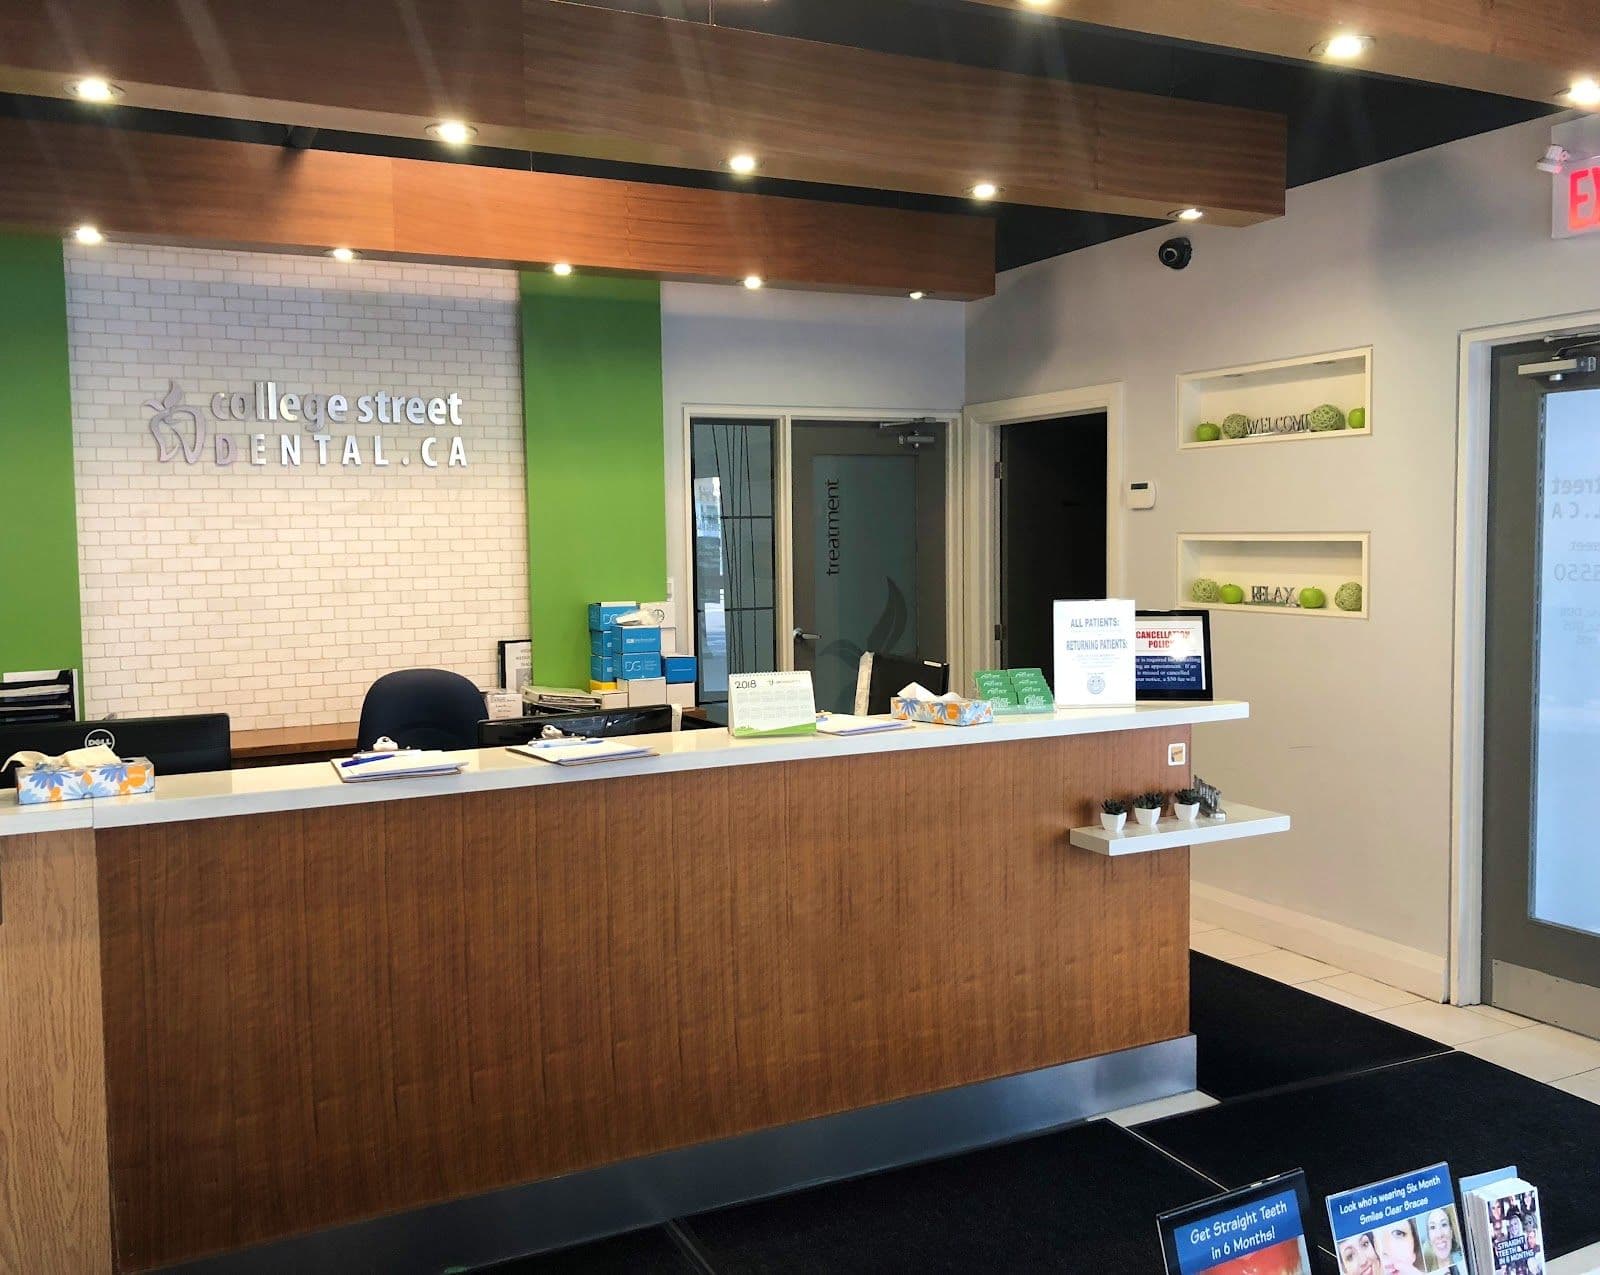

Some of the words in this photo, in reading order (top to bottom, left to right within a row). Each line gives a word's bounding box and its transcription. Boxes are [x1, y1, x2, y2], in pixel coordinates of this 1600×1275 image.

[211, 381, 348, 433] college
[357, 390, 463, 426] street
[826, 479, 840, 576] treatment
[1070, 618, 1083, 628] ALL
[1085, 617, 1120, 628] PATIENTS:
[1066, 640, 1098, 651] RETURNING
[1100, 638, 1128, 650] PATIENTS:
[734, 680, 757, 689] 2018
[1339, 1202, 1358, 1215] Look
[1358, 1196, 1378, 1207] who's
[1378, 1188, 1406, 1200] wearing
[1406, 1183, 1418, 1194] Six
[1418, 1175, 1441, 1189] Month
[1359, 1211, 1384, 1225] Smiles
[1384, 1204, 1404, 1217] Clear
[1403, 1197, 1429, 1210] Braces
[1190, 1227, 1211, 1245] Get
[1213, 1211, 1258, 1236] Straight
[1260, 1200, 1288, 1220] Teeth
[1211, 1246, 1221, 1260] in
[1223, 1241, 1231, 1255] 6
[1233, 1225, 1276, 1252] Months!
[1498, 1237, 1524, 1249] STRAIGHT
[1498, 1247, 1516, 1256] TEETH
[1511, 1250, 1535, 1261] MONTHS
